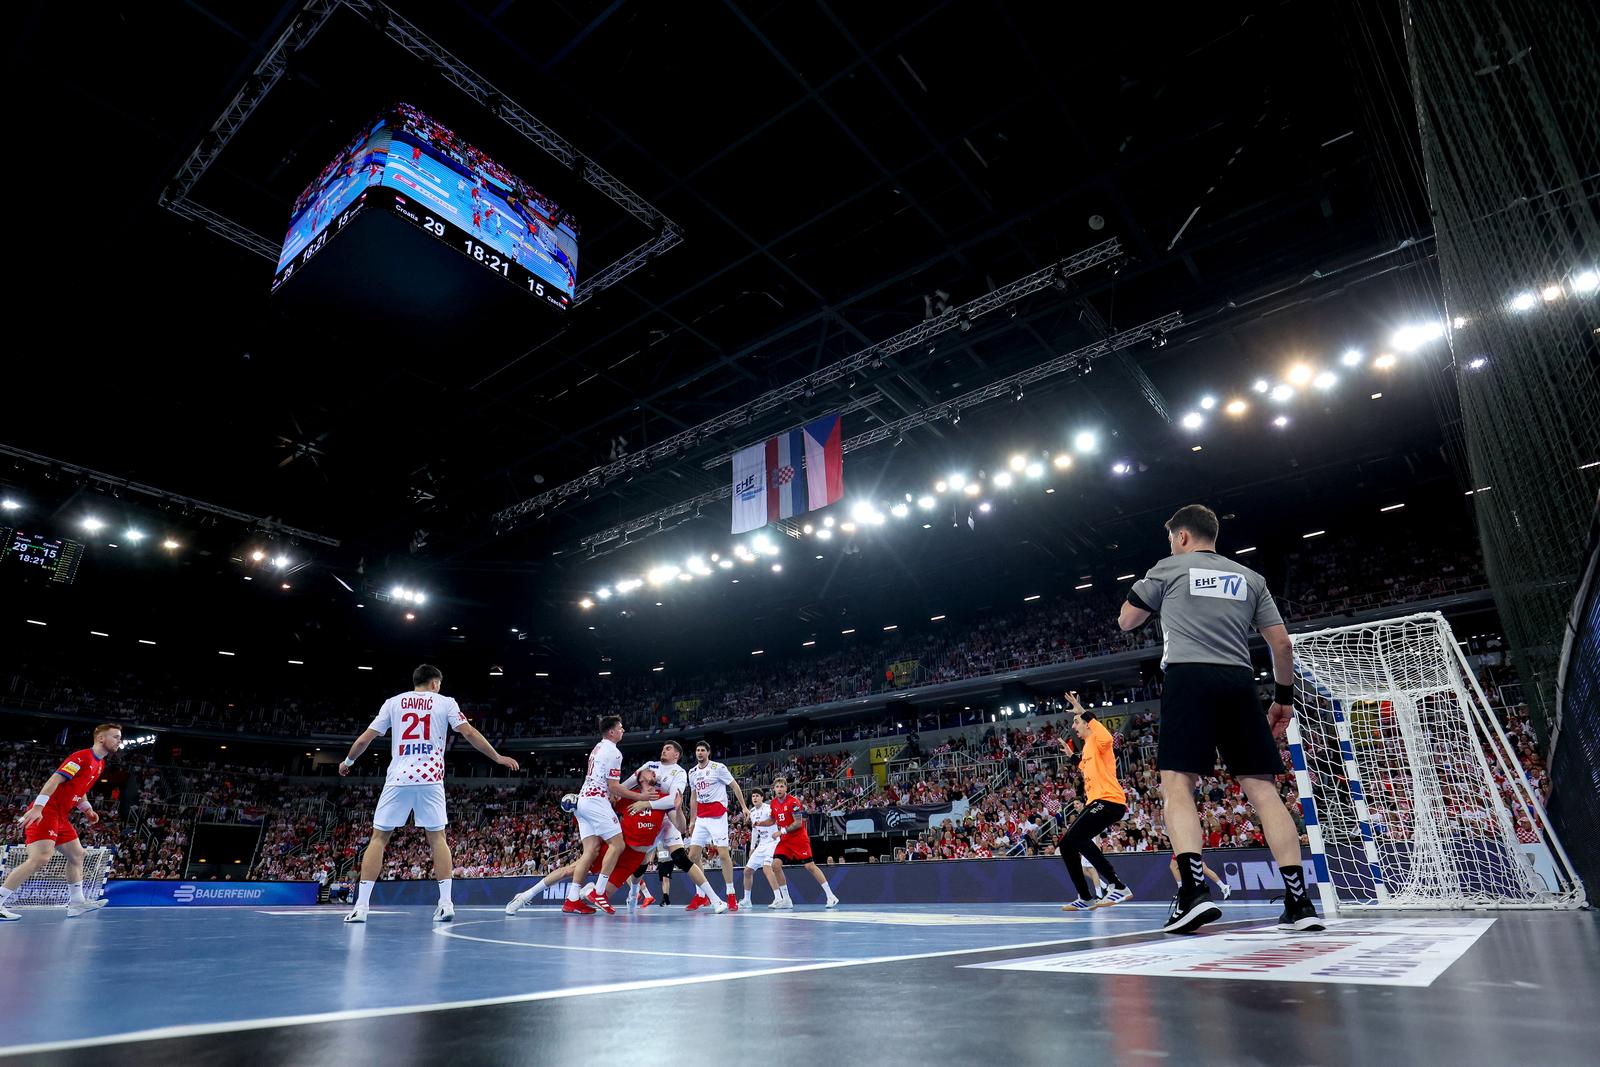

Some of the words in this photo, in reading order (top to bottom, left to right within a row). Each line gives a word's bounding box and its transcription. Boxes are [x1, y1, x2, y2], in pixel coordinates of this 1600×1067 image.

[395, 204, 419, 222] Croatia
[423, 216, 445, 237] 29
[464, 240, 509, 277] 18:21
[527, 279, 544, 297] 15
[735, 474, 755, 494] EHF
[12, 541, 28, 552] 29
[43, 548, 58, 559] 15
[18, 553, 45, 566] 18:21
[1195, 577, 1217, 587] EHF
[1218, 574, 1243, 597] TV
[401, 696, 433, 711] GAVRIĆ
[401, 712, 431, 741] 21
[412, 743, 434, 755] HEP
[695, 780, 706, 790] 30
[195, 888, 263, 899] BAUERFEIND
